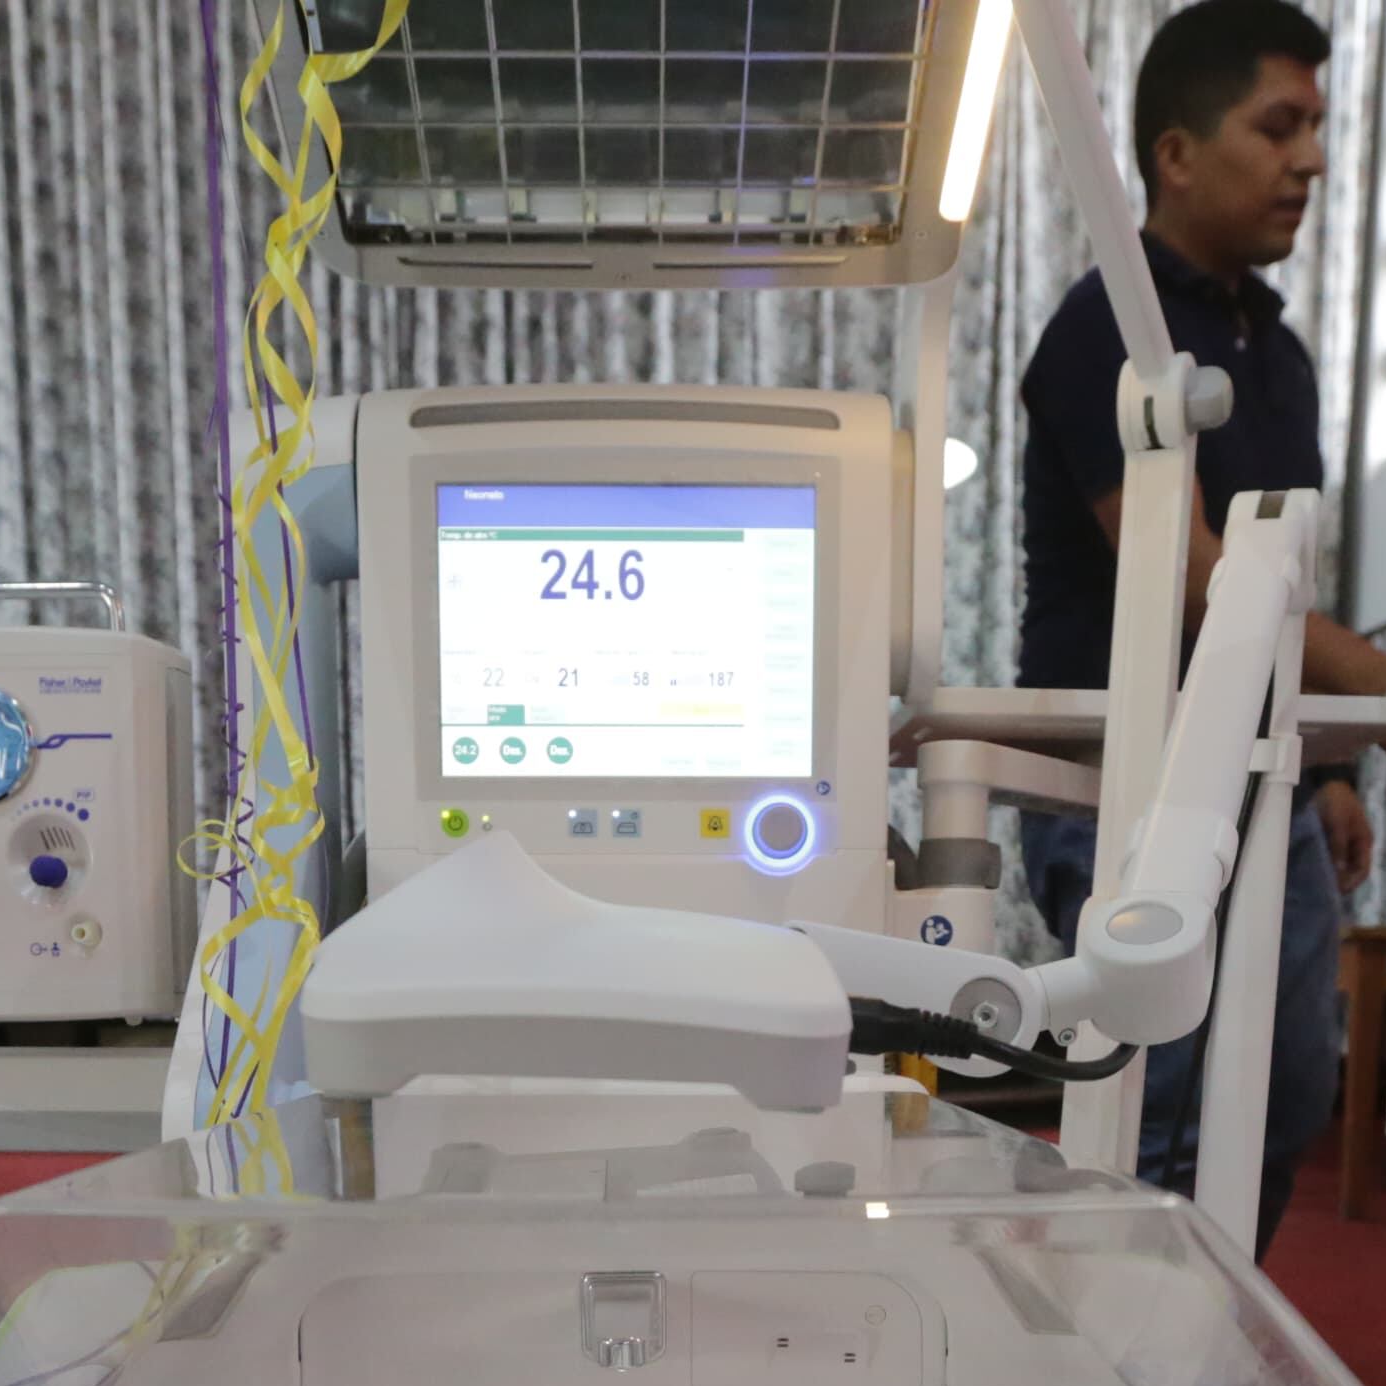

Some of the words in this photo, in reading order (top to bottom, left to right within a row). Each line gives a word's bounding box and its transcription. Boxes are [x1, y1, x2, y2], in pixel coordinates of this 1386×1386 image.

[540, 549, 645, 600] 24.6
[483, 667, 505, 687] 22
[558, 667, 580, 687] 21
[633, 671, 650, 687] 58
[708, 671, 735, 687] 187
[455, 745, 477, 755] 24.2
